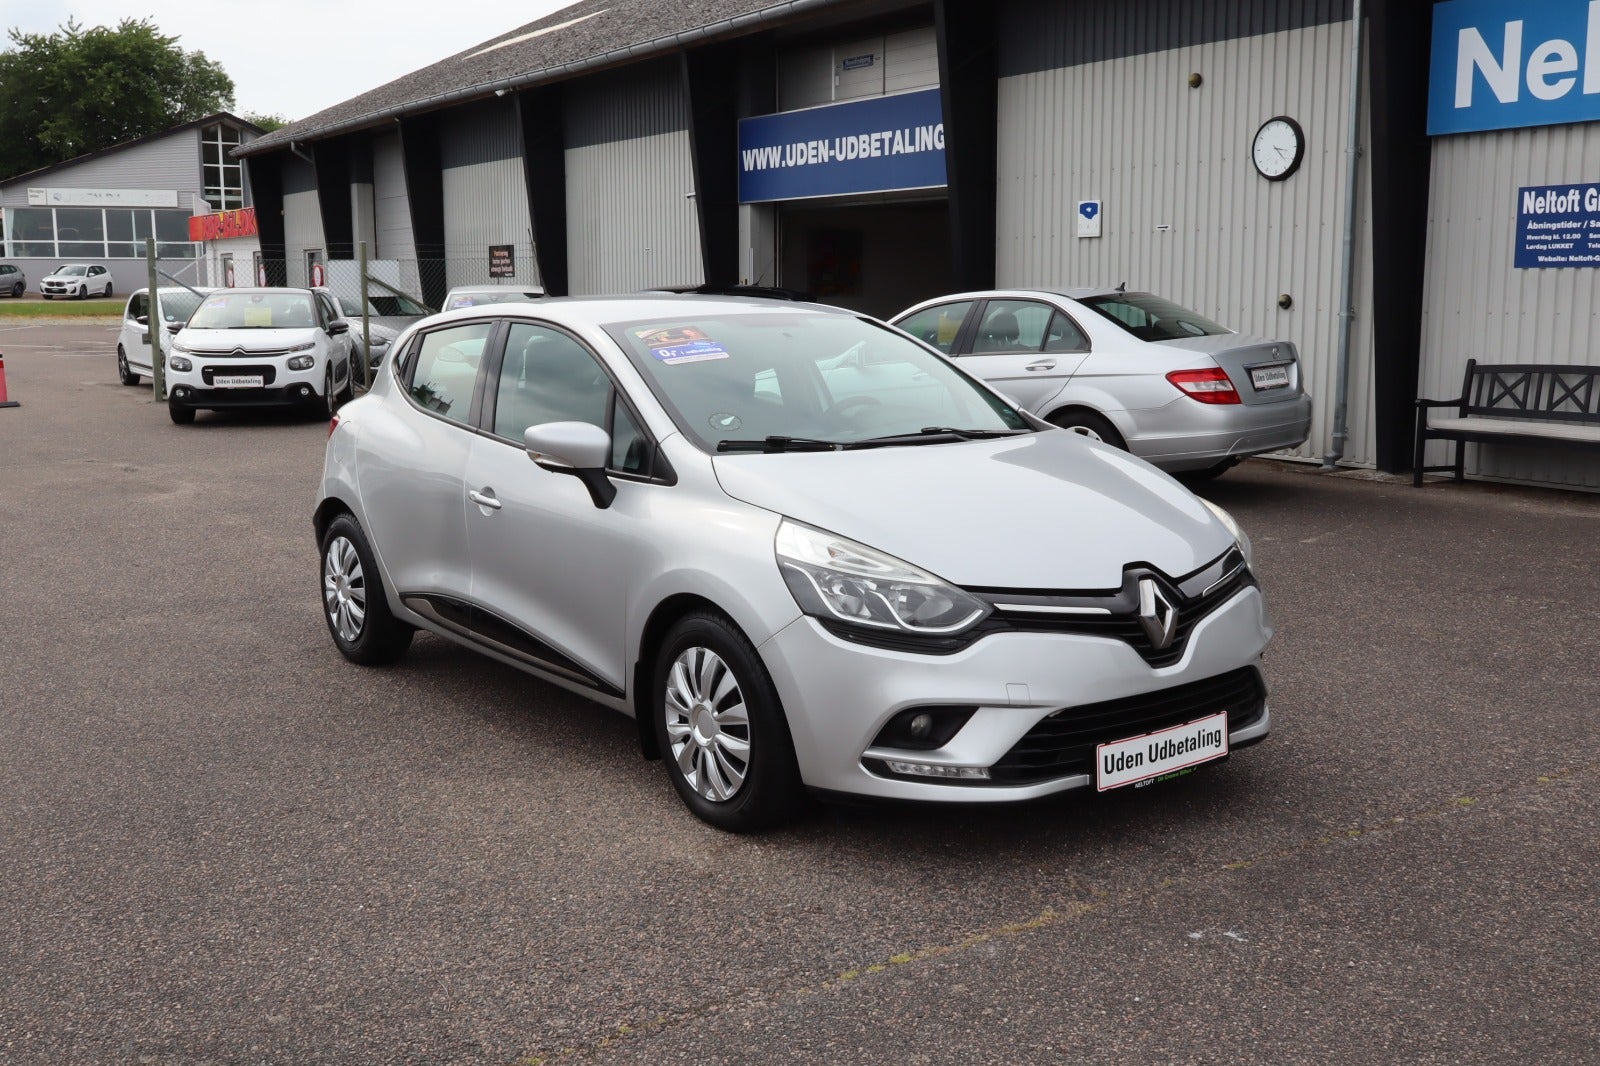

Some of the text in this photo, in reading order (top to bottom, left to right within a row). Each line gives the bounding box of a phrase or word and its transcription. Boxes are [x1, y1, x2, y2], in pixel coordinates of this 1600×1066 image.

[742, 123, 946, 172] WWW.UDEN-UDBETALING
[1522, 187, 1600, 214] Neltoft G
[1527, 220, 1582, 230] Åbningstider
[1103, 751, 1143, 775] Uden
[1148, 729, 1222, 763] Udbetaling
